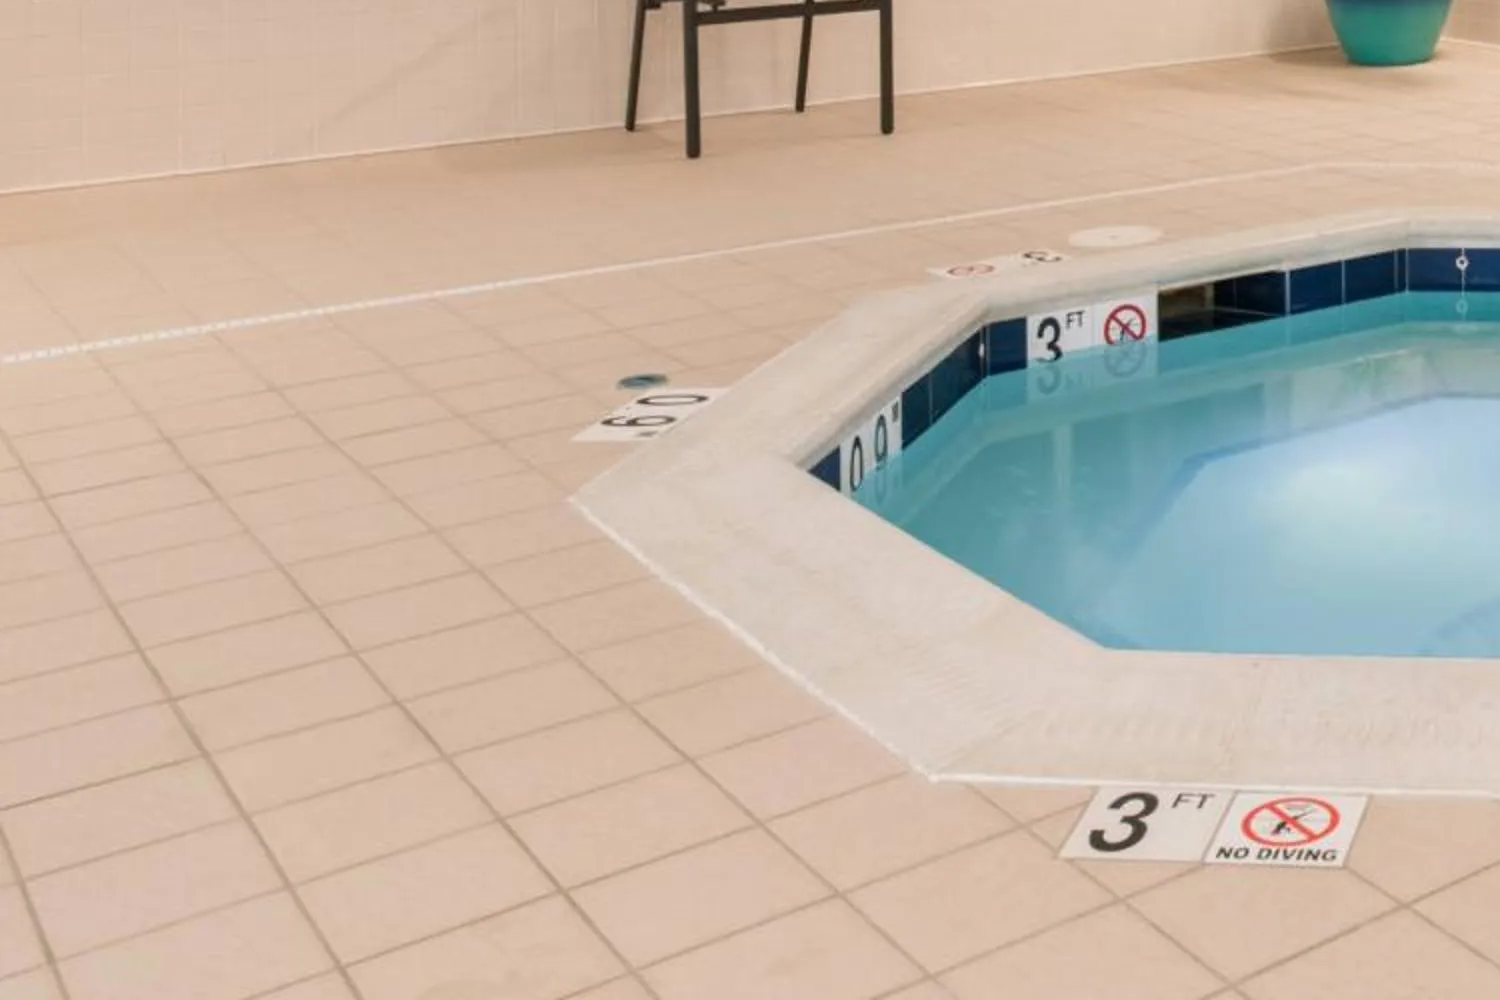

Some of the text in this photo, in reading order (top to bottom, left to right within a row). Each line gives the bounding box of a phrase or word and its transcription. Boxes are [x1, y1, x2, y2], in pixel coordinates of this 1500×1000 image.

[1036, 310, 1085, 364] 3 FT
[1088, 791, 1215, 853] 3 FT
[1215, 846, 1339, 862] NO DIVING
